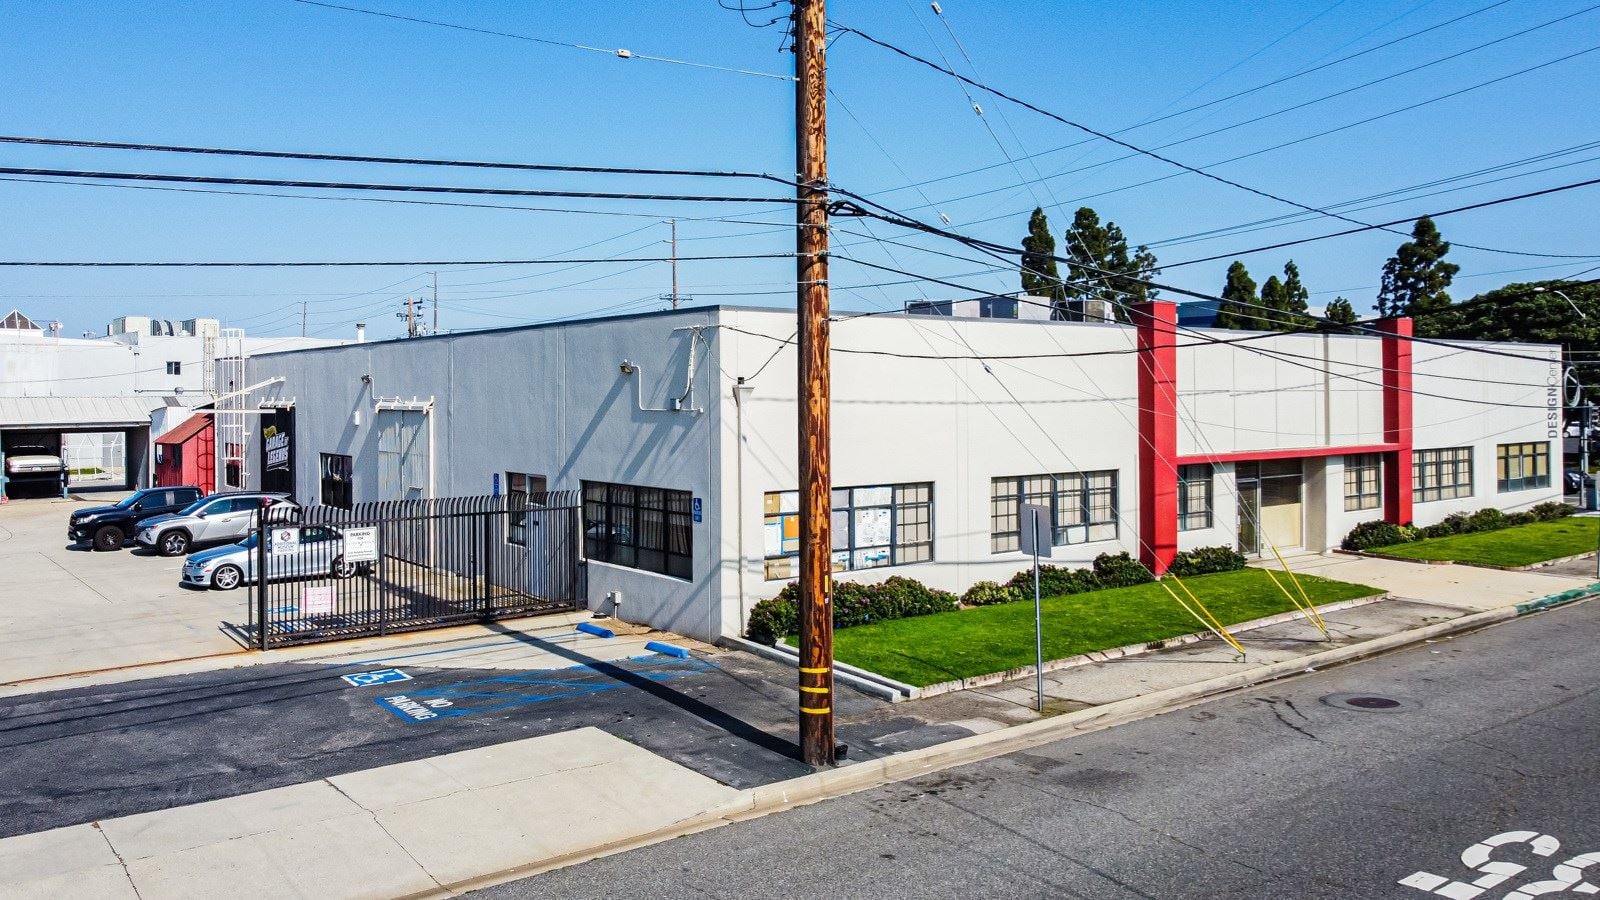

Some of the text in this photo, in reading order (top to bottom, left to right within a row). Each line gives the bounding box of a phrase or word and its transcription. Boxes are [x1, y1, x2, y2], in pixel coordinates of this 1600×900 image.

[266, 432, 285, 452] GARAGE
[267, 445, 289, 465] LEGENDS
[384, 695, 438, 720] PARKING
[423, 698, 454, 708] NO
